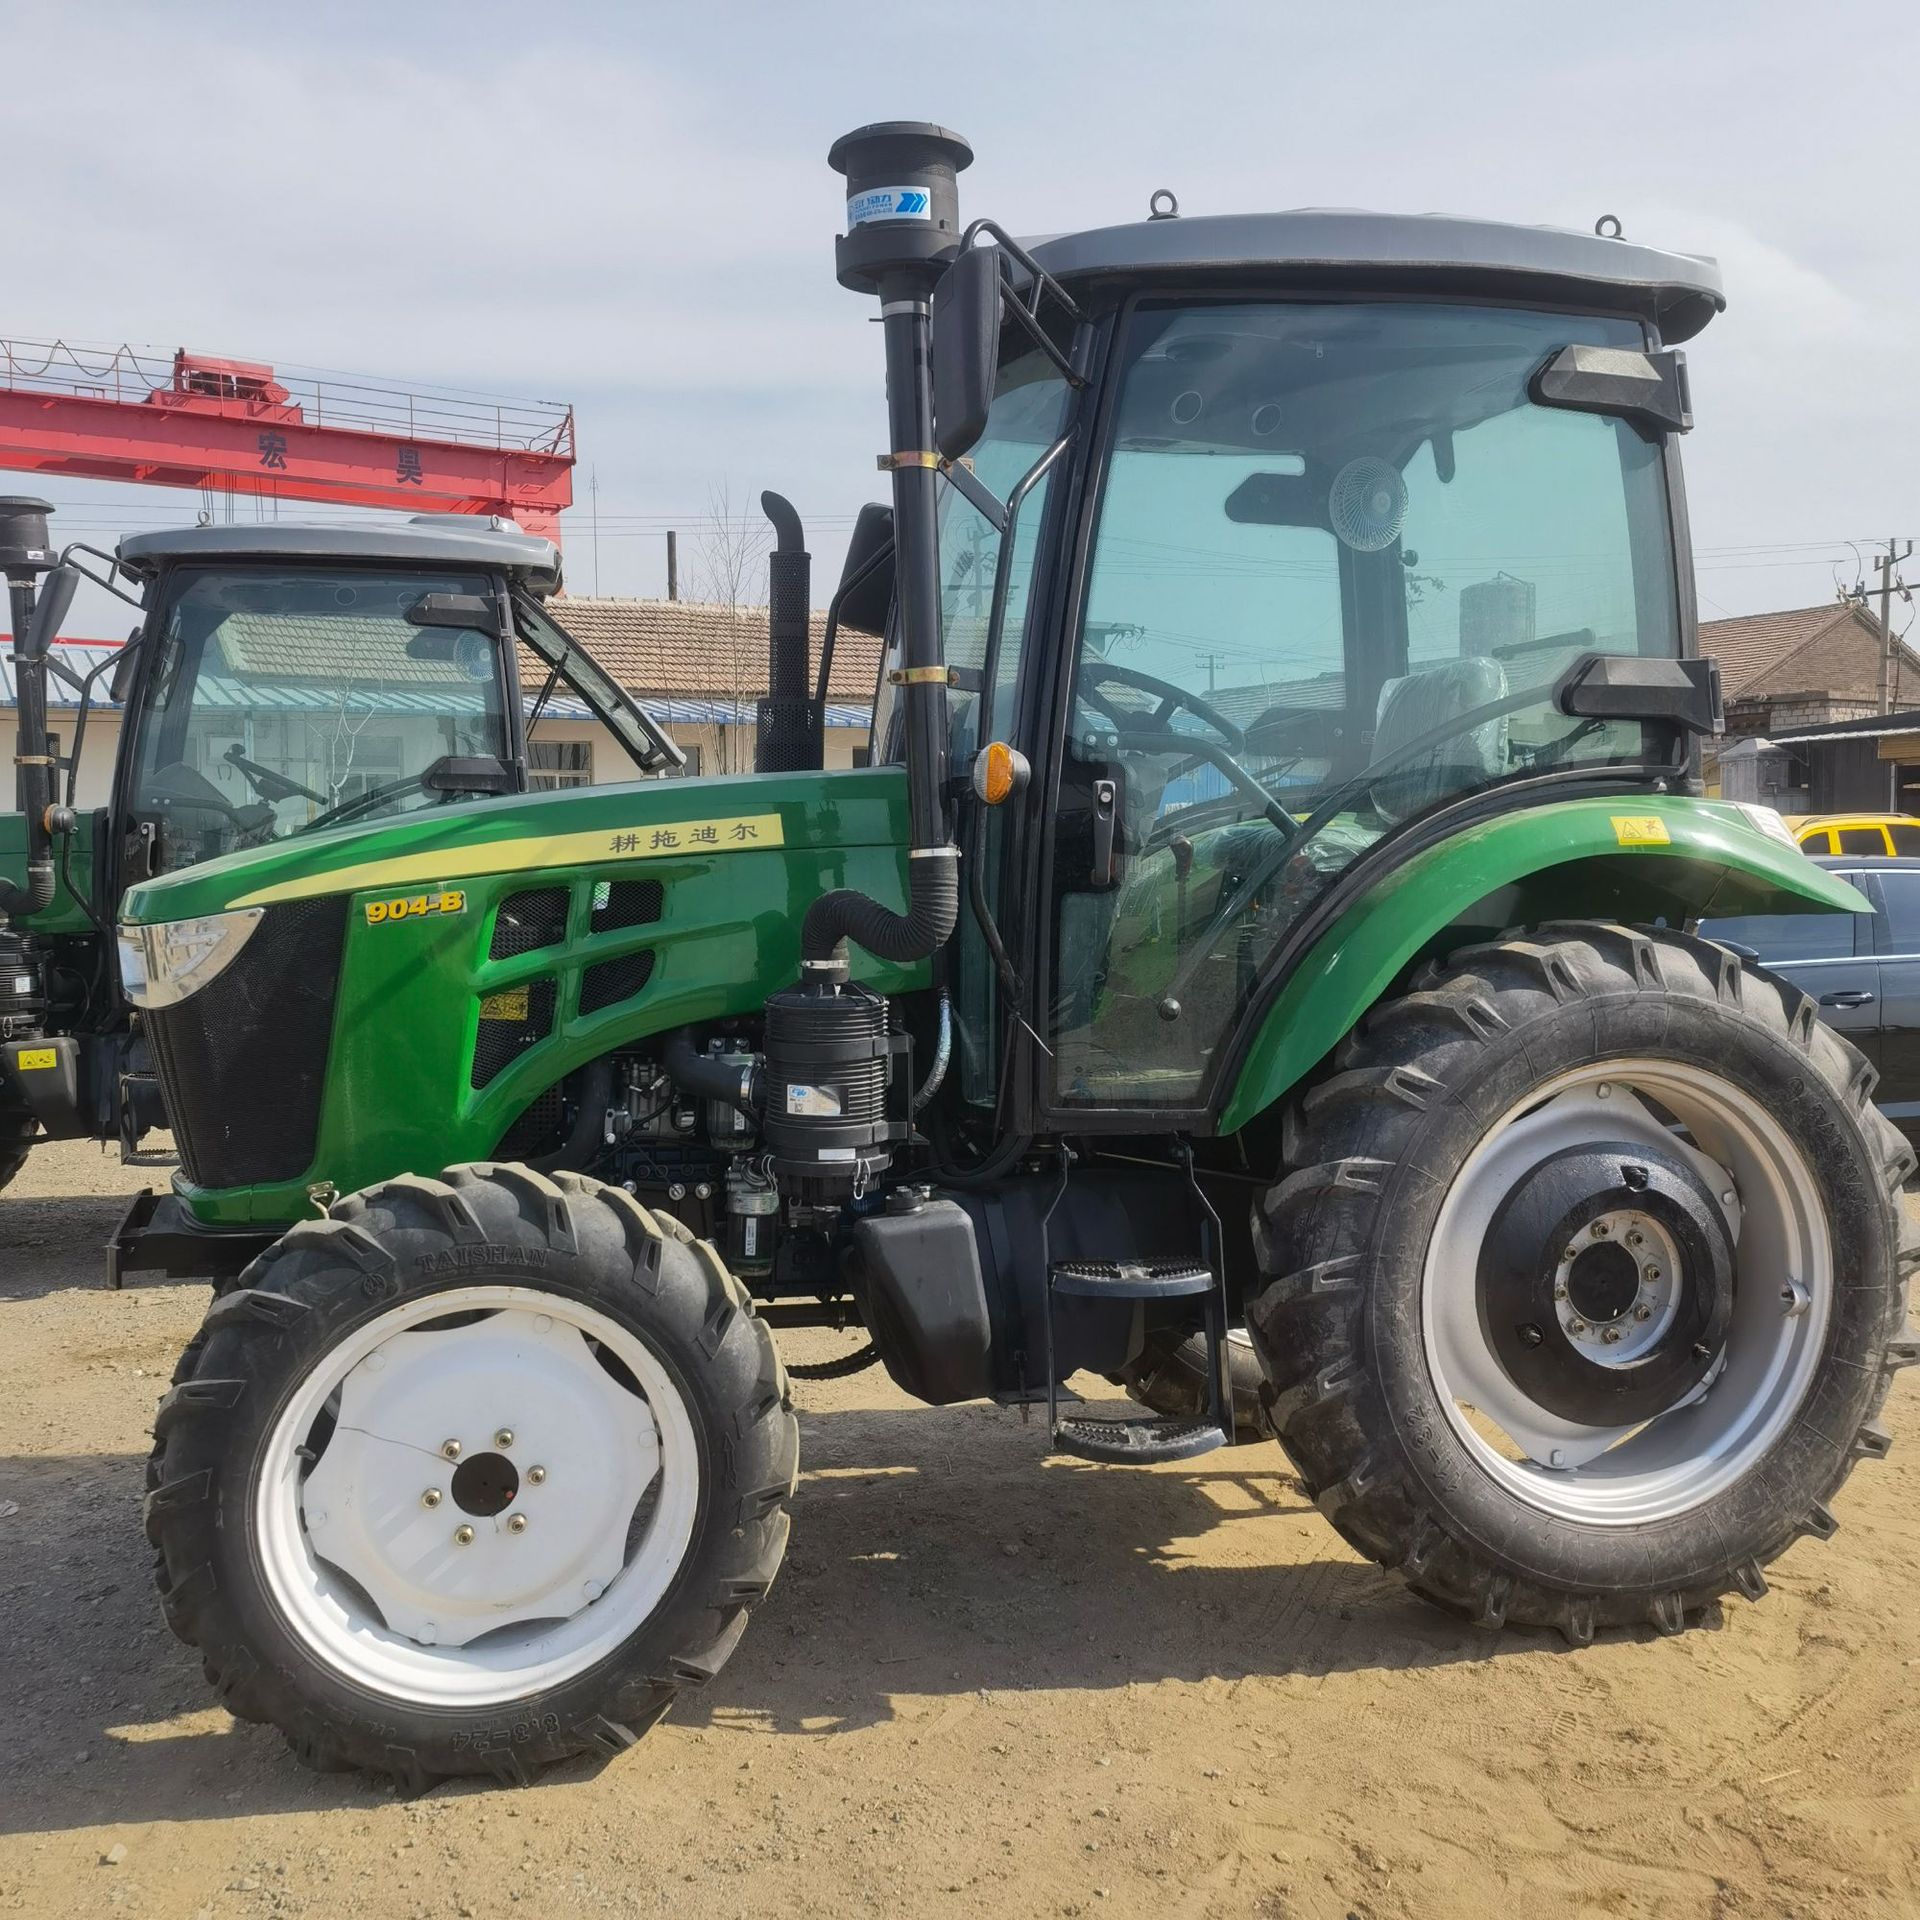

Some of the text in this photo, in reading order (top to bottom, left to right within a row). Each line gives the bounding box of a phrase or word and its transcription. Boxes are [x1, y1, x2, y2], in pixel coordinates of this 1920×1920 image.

[609, 823, 759, 853] 耕拖迪尔
[367, 890, 464, 924] 904-B
[417, 1244, 550, 1273] TAISHAN
